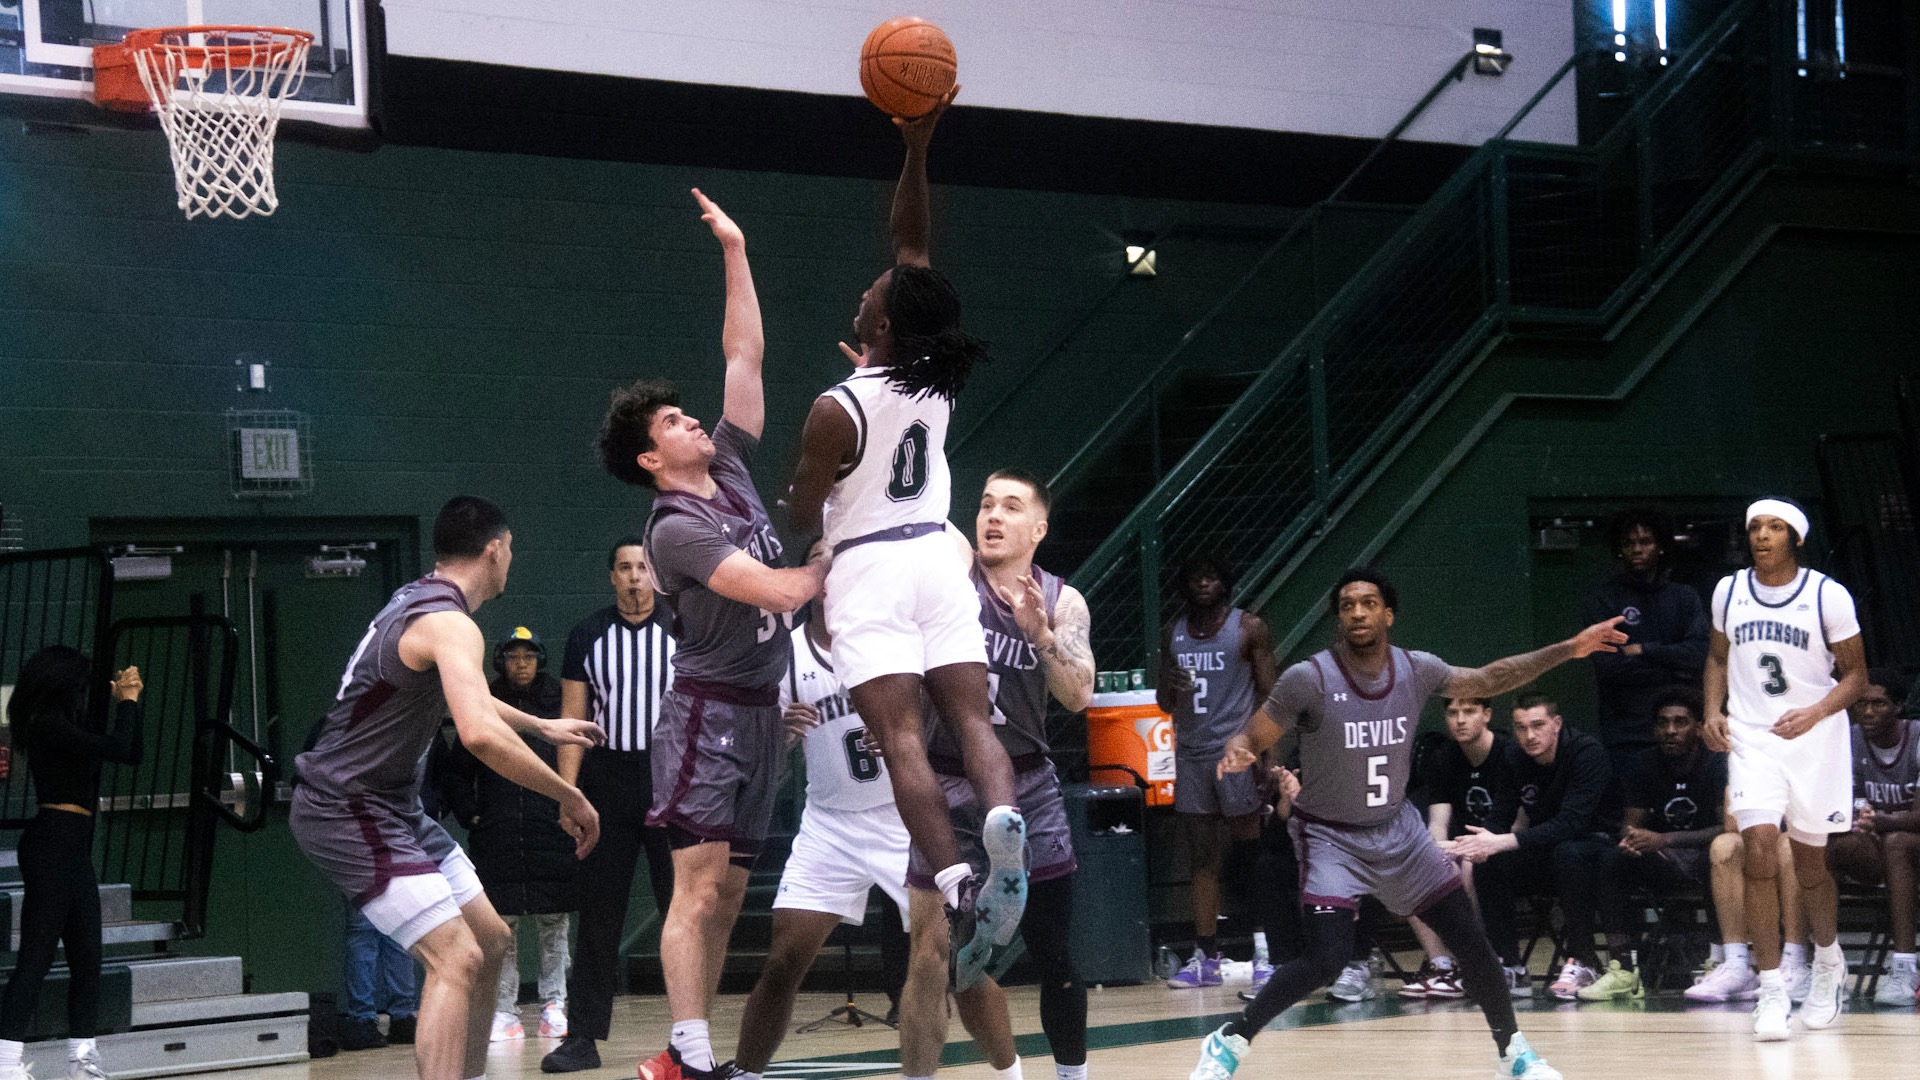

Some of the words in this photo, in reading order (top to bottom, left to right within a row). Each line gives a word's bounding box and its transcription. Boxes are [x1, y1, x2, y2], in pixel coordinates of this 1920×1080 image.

[253, 433, 289, 471] EXIT
[885, 419, 930, 503] 0
[982, 626, 1039, 670] EVILS
[1734, 619, 1810, 652] STEVENSON
[1177, 651, 1226, 671] DEVILS
[1757, 652, 1790, 698] 3
[1193, 677, 1208, 714] 2
[1153, 720, 1172, 752] G
[1344, 716, 1408, 750] DEVILS
[1366, 755, 1390, 808] 5
[1865, 780, 1915, 804] DEVILS
